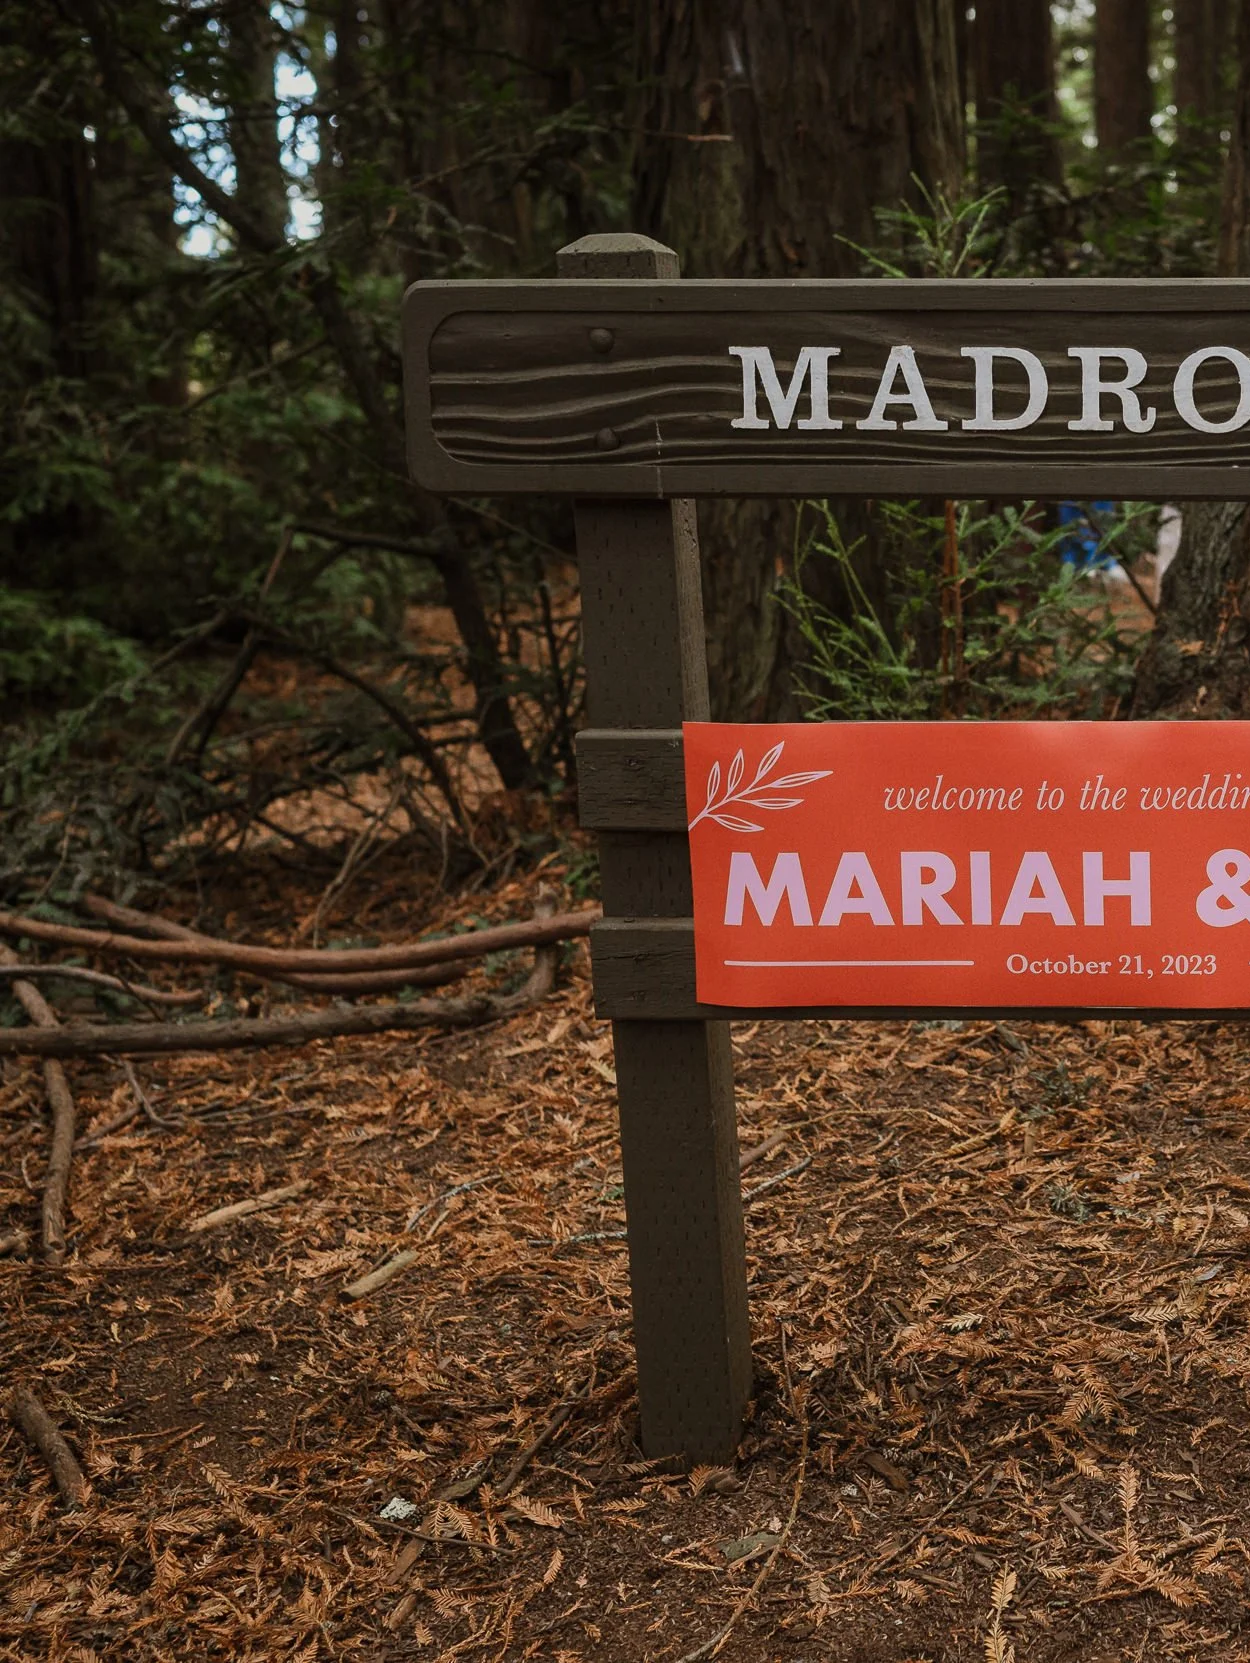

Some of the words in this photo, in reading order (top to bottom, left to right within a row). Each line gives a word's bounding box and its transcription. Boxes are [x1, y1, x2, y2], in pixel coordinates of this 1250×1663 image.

[883, 774, 1023, 811] welcome
[1036, 780, 1065, 811] to
[1079, 774, 1128, 811] the
[724, 850, 1152, 927] MARIAH
[1006, 953, 1112, 975] October
[1118, 954, 1154, 979] 21,
[1161, 954, 1217, 976] 2023
